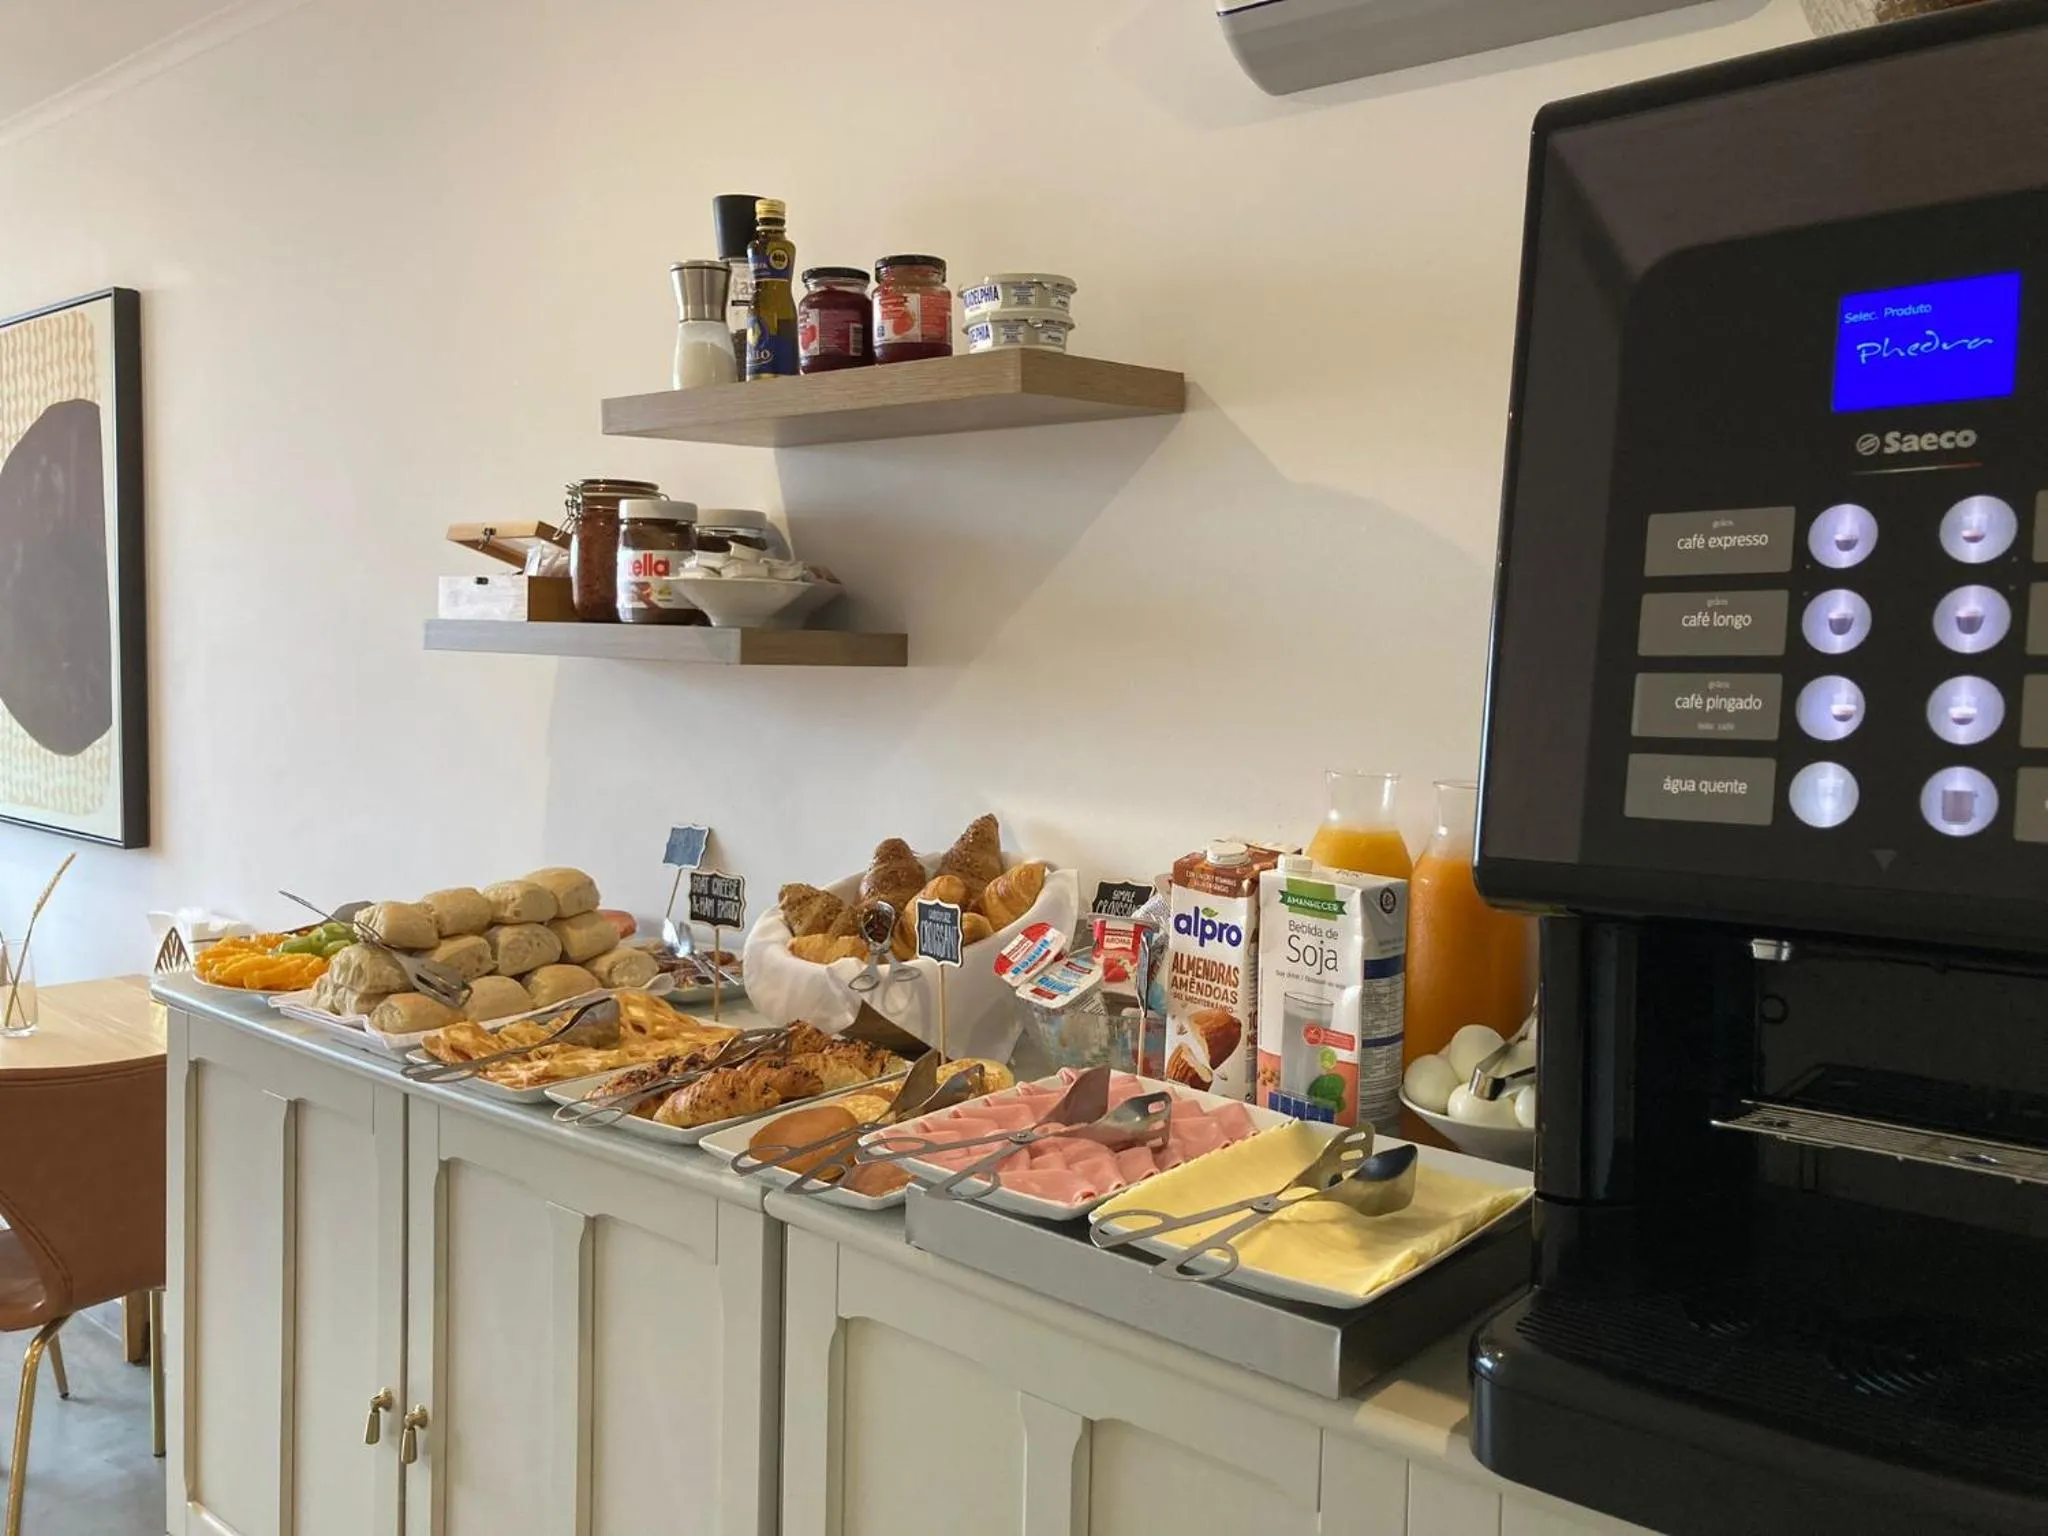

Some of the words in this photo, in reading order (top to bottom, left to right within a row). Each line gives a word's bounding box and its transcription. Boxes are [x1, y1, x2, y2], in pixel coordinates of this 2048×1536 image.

[1884, 304, 1932, 318] Produto
[1856, 330, 1994, 364] Phedra
[1883, 429, 1978, 454] Saeco
[1677, 533, 1705, 550] café
[1708, 533, 1769, 550] expresso
[1681, 611, 1710, 628] café
[1713, 611, 1752, 630] longo
[1675, 694, 1703, 710] café
[1706, 694, 1762, 713] pingado
[1663, 776, 1696, 794] água
[1699, 778, 1748, 795] quente
[1286, 896, 1339, 912] AMANHECER
[1173, 906, 1242, 947] alpro
[1288, 920, 1322, 938] Bebida
[1325, 927, 1339, 940] de
[1286, 934, 1339, 975] Soja
[1172, 951, 1240, 989] ALMENDRAS
[1171, 975, 1238, 1005] AMÊNDOAS
